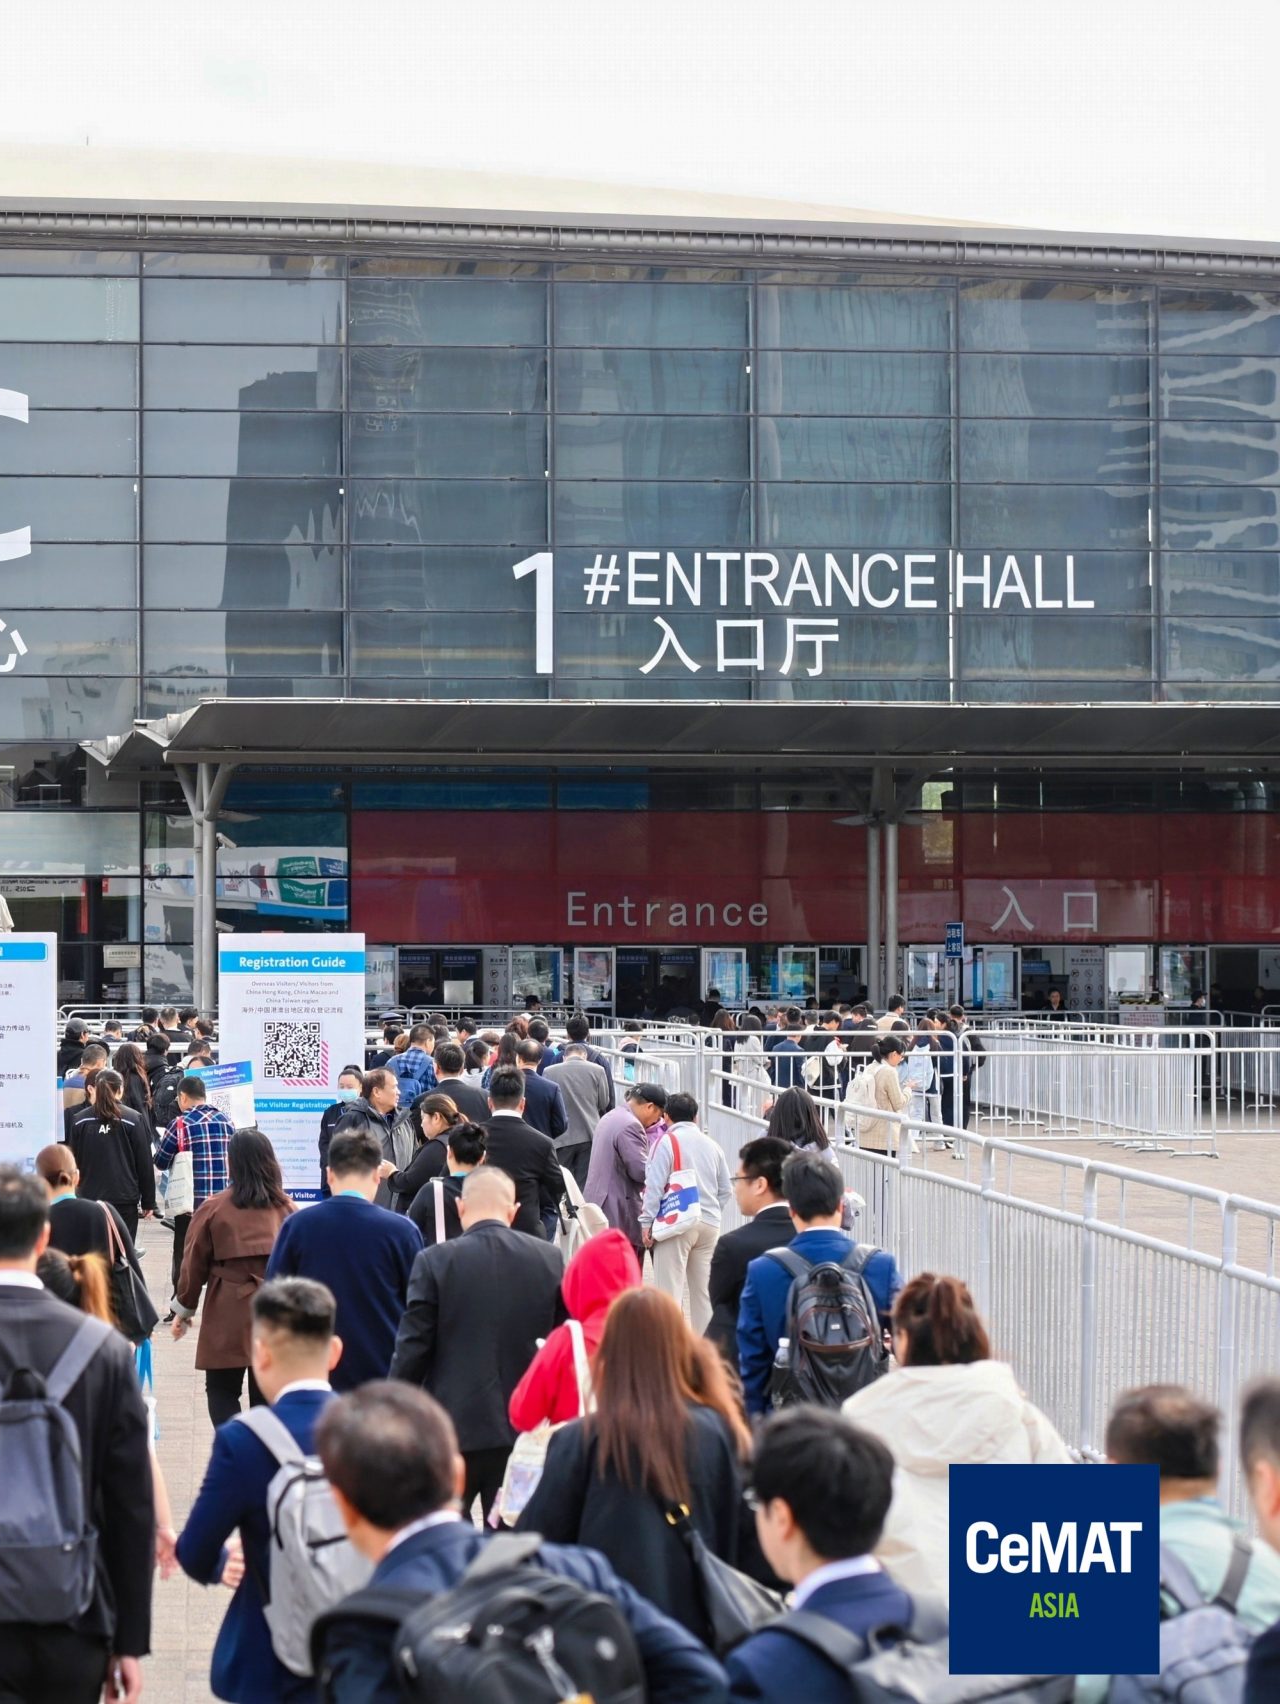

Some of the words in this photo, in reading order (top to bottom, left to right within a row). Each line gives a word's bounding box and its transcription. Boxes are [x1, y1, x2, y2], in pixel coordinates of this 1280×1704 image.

[583, 551, 937, 608] #ENTRANCE
[955, 553, 1095, 609] HALL
[639, 615, 839, 677] 入口厅
[567, 891, 769, 927] Entrance
[990, 885, 1098, 933] 入口
[239, 956, 309, 970] Registration
[312, 956, 346, 968] Guide
